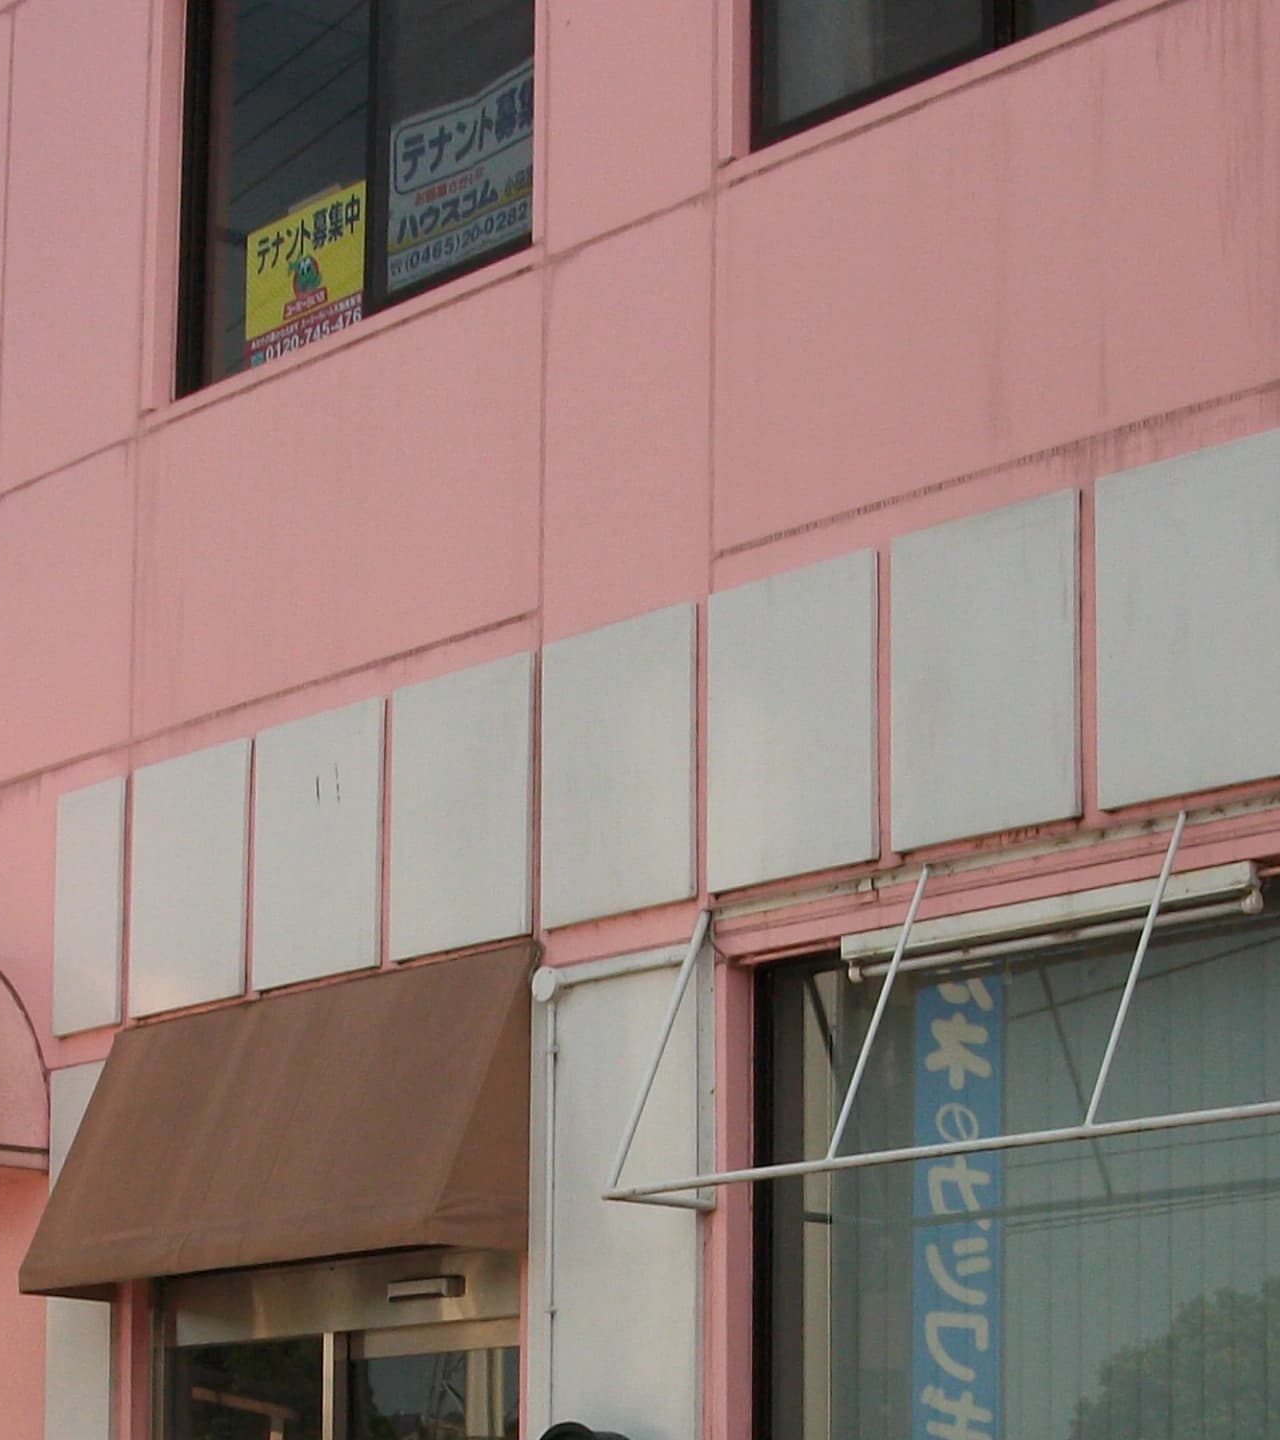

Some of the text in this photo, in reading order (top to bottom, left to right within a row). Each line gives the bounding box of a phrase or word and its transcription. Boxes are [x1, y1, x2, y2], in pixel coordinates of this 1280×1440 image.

[256, 192, 361, 275] テナント募集中
[397, 178, 498, 244] ハウスコム
